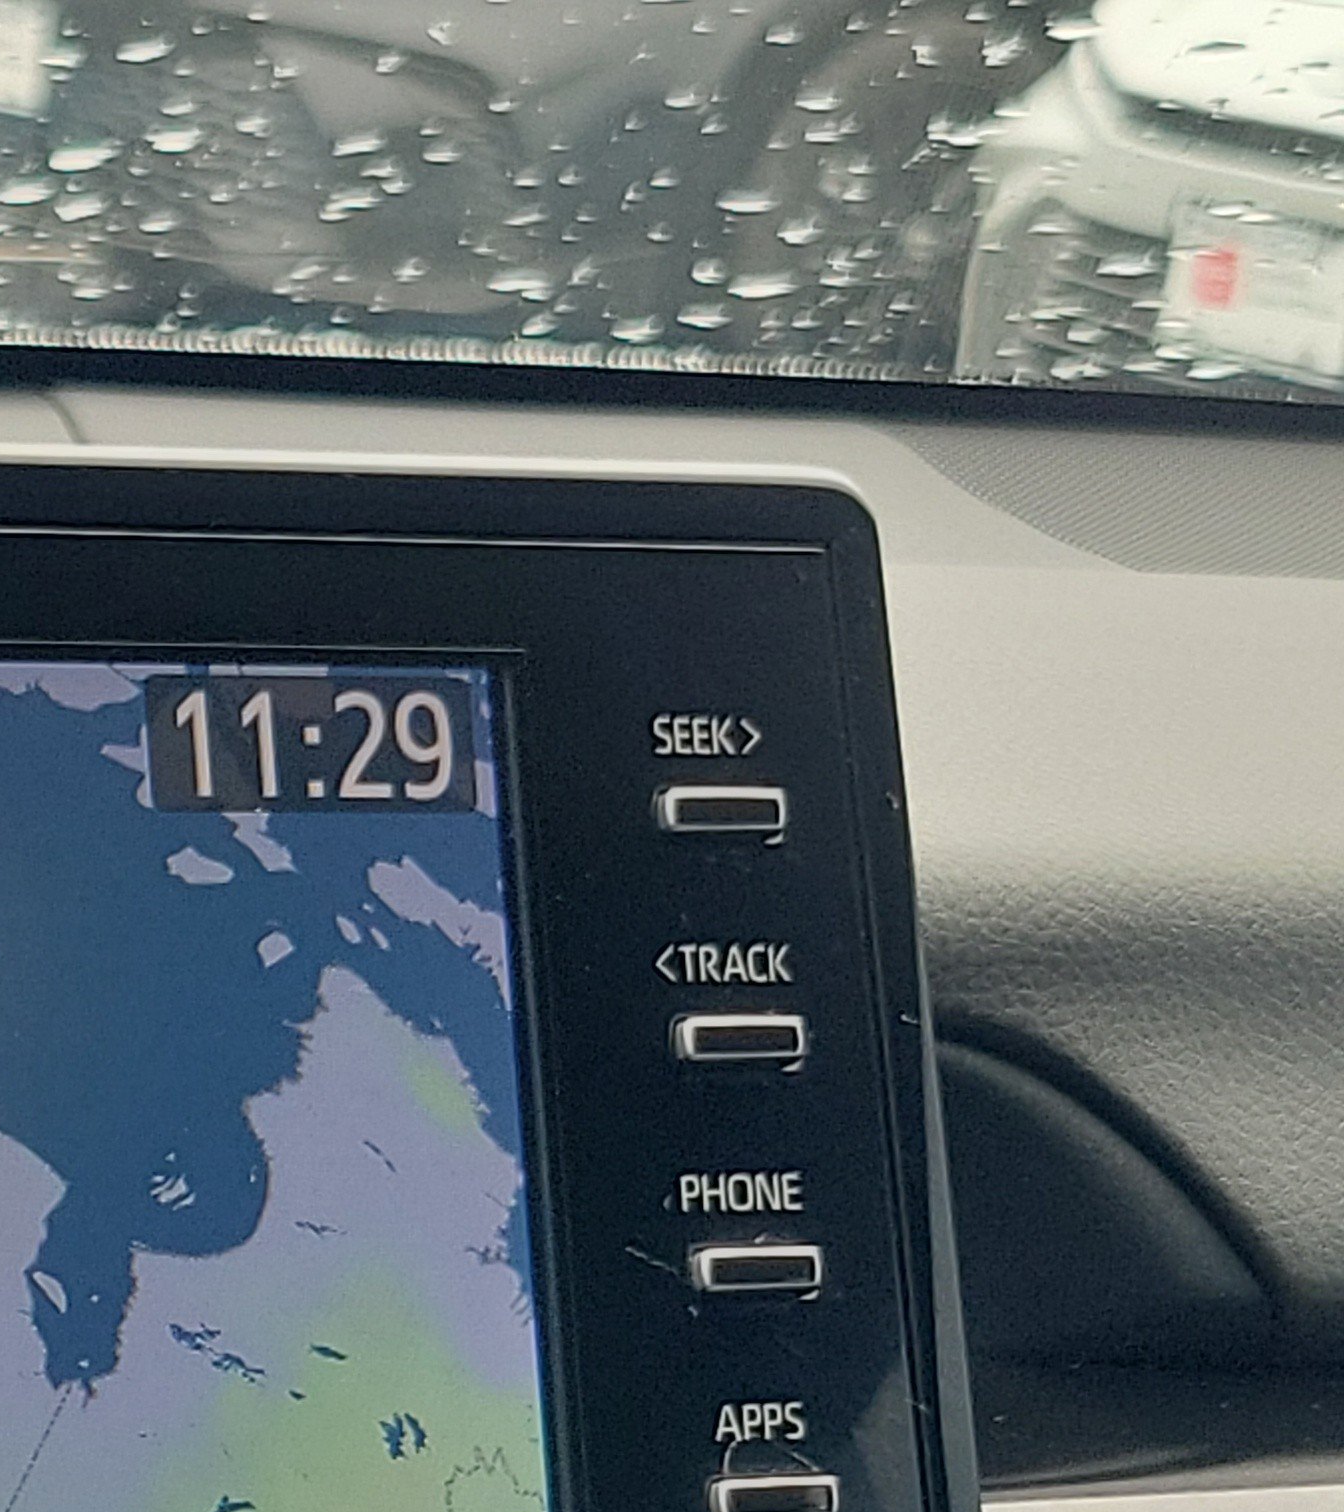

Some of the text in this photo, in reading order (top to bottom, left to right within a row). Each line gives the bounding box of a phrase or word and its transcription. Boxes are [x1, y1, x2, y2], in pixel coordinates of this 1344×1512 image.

[175, 690, 453, 801] 11:29
[679, 1170, 805, 1213] PHONE
[714, 1401, 806, 1442] APPS
